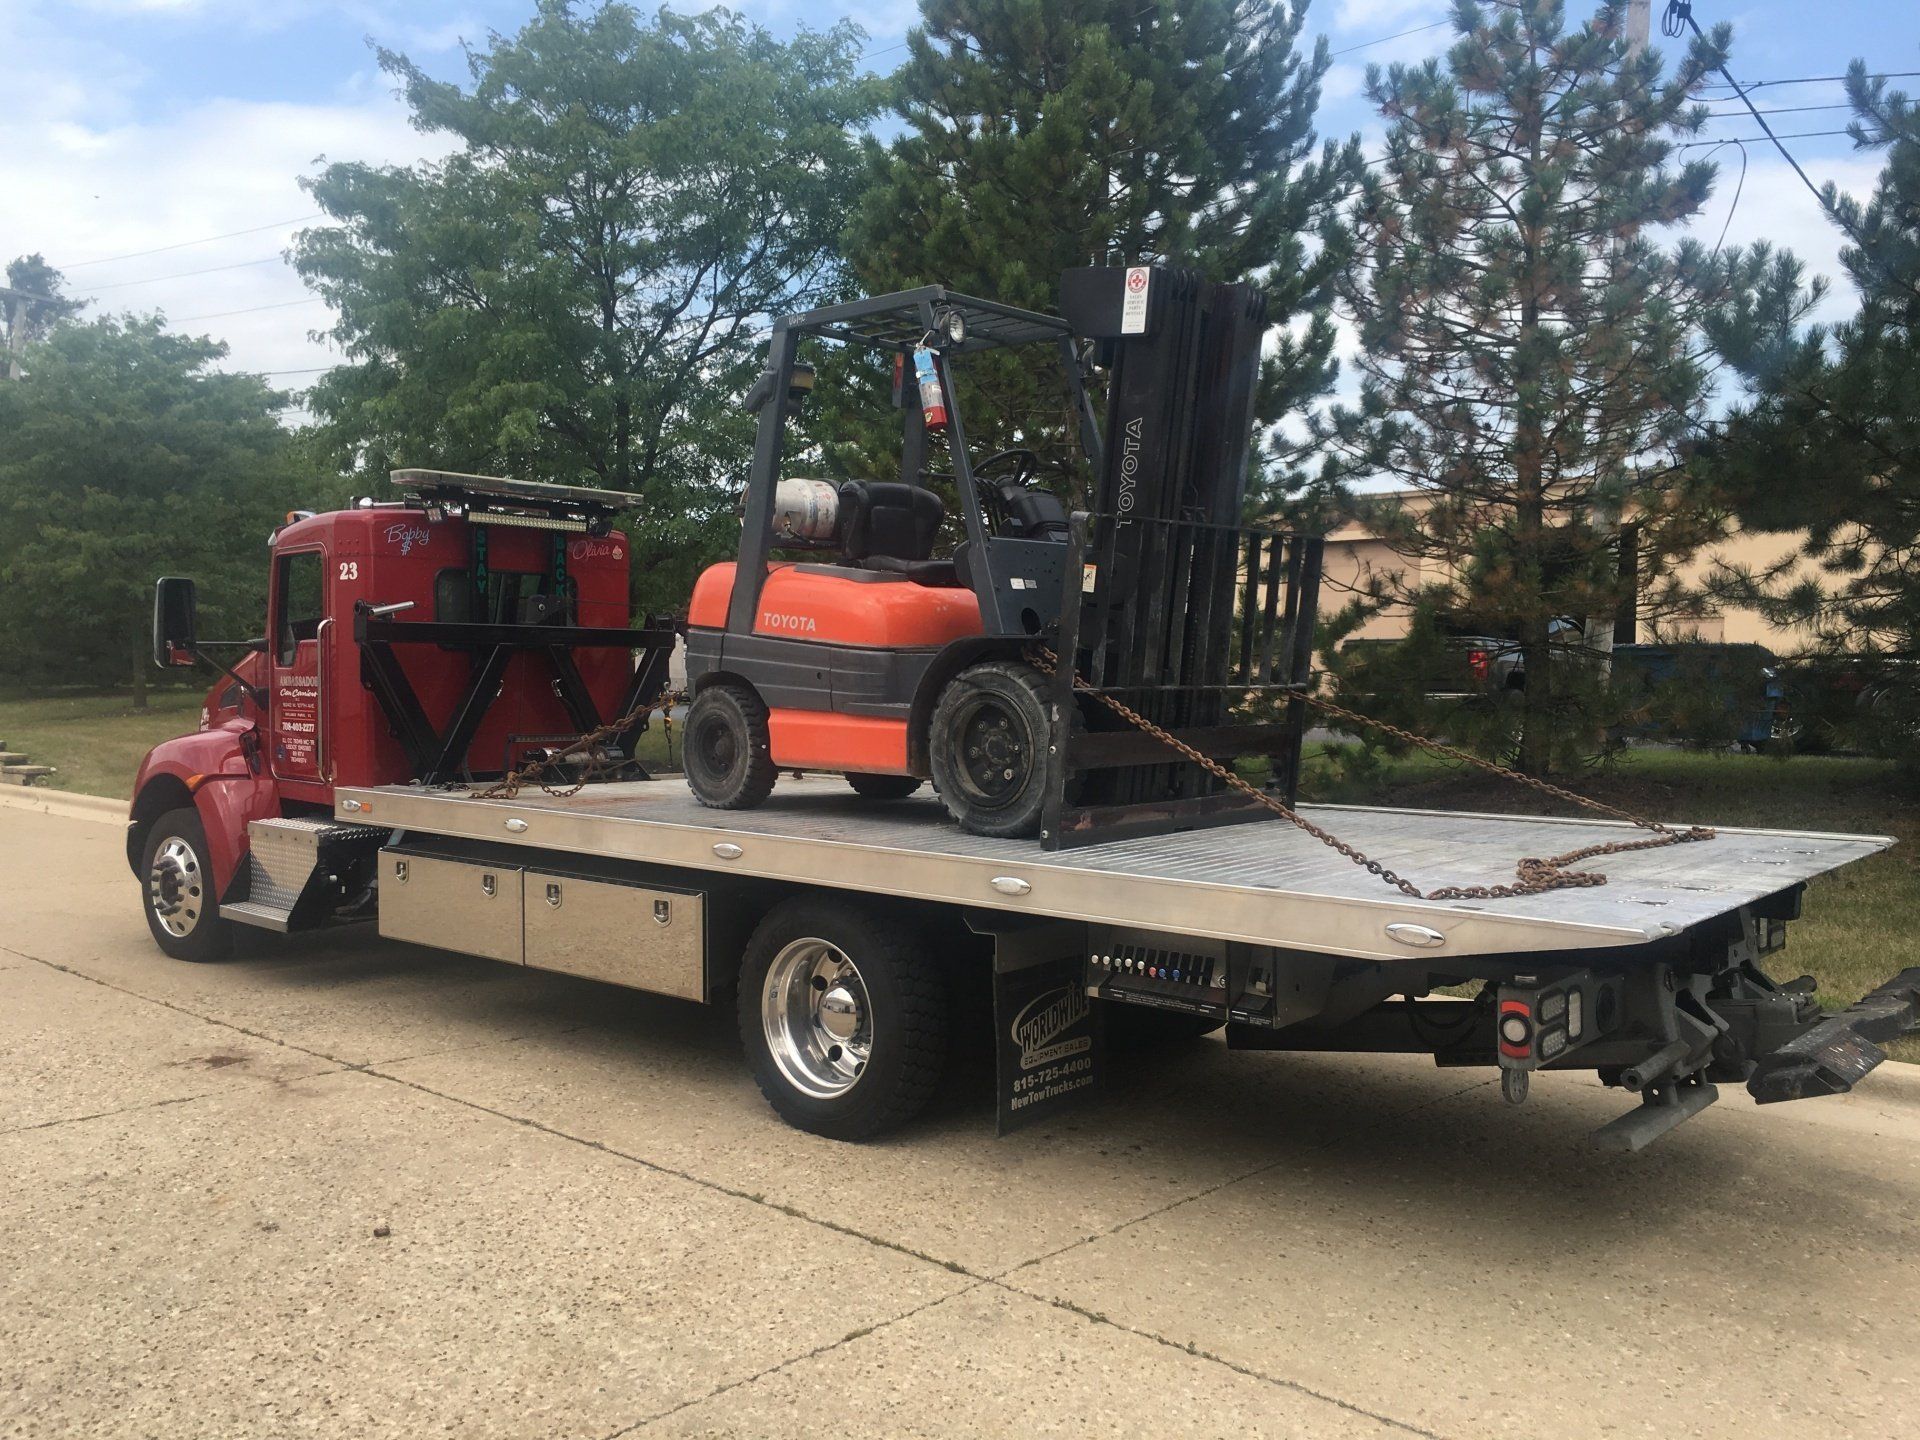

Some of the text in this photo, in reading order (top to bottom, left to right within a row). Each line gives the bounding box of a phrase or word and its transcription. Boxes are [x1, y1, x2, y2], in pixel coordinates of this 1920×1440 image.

[1116, 417, 1143, 528] TOYOTA
[476, 529, 487, 593] STAY
[555, 535, 566, 597] BACK
[572, 540, 610, 560] Olivia
[339, 562, 358, 580] 23
[763, 612, 816, 632] TOYOTA
[1024, 1038, 1088, 1066] EQUIPMENT SALES
[1011, 1074, 1093, 1111] NewTowTrucks.com
[1013, 1057, 1092, 1093] 815-725-4400
